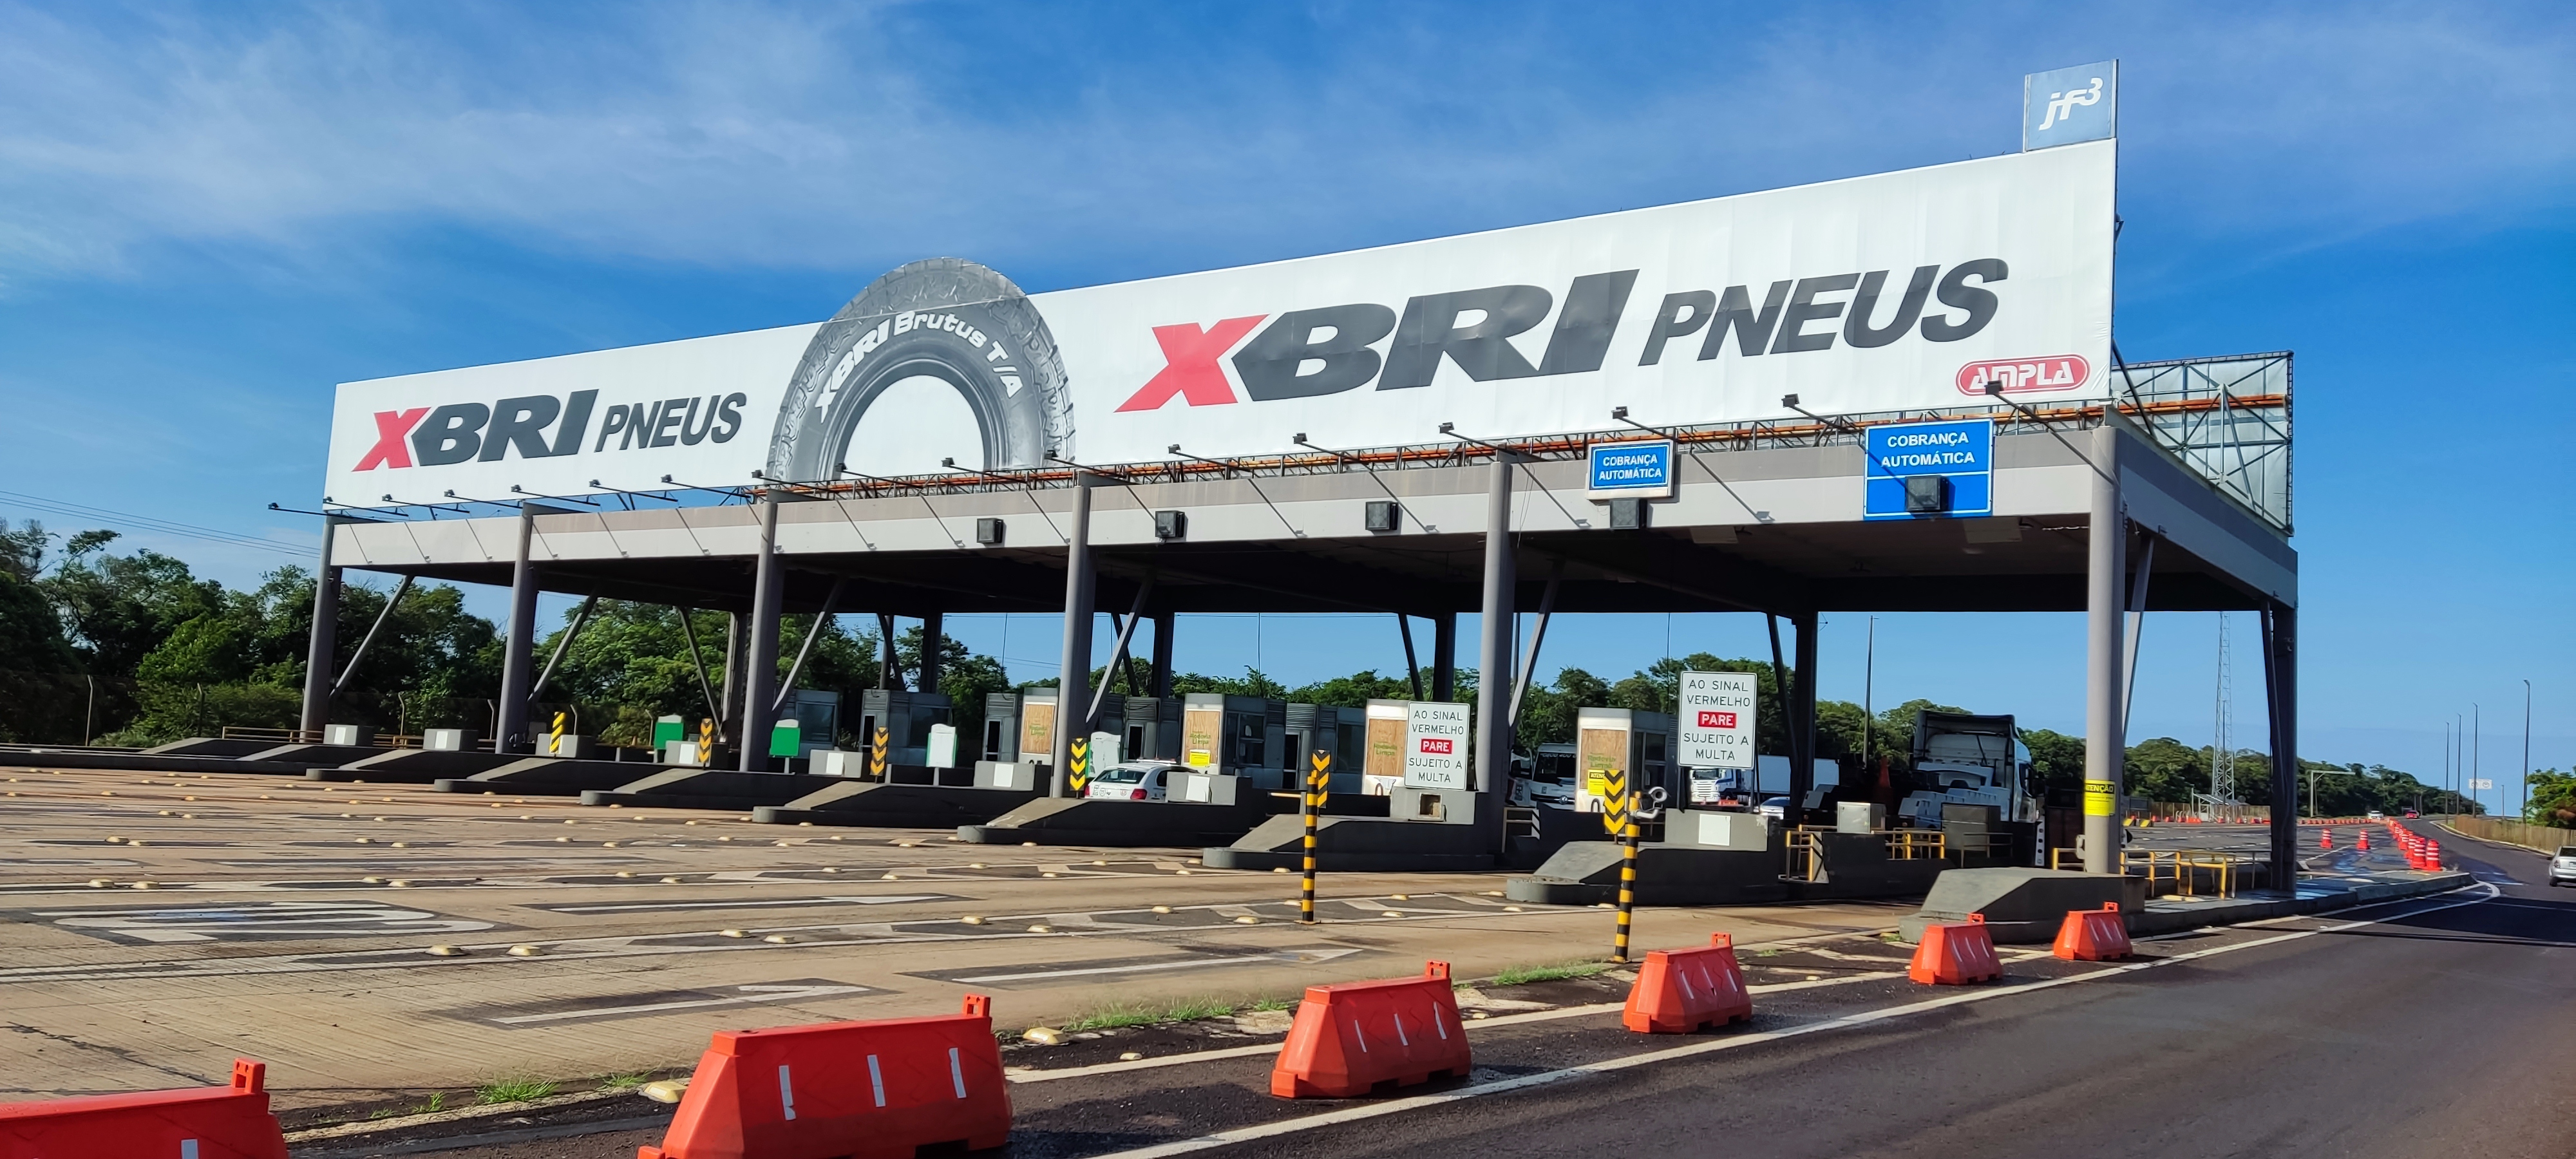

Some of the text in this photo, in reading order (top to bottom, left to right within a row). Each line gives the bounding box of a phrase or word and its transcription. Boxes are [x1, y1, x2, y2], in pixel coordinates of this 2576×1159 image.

[1113, 258, 2009, 413] XBRI PNEUS
[814, 310, 1023, 424] XBRI Brutus T/A
[1969, 361, 2076, 390] AMPLA
[351, 389, 746, 472] XBRI PNEUS
[1888, 432, 1969, 447] COBRANÇA
[1603, 455, 1658, 466] COBRANÇA
[1881, 451, 1975, 467] AUTOMÁTICA
[1598, 467, 1662, 480] AUTOMÁTICA
[1689, 679, 1748, 692] AO SINAL
[1687, 695, 1750, 706] VERMELHO
[1414, 710, 1463, 721] AO SINAL
[1701, 713, 1734, 726] PARE
[1412, 724, 1464, 735] VERMELHO
[1684, 733, 1748, 745] SUJEITO A
[1423, 741, 1450, 752] PARE
[1696, 749, 1735, 760] MULTA
[1409, 758, 1463, 769] SUJEITO A
[1419, 772, 1451, 782] MULTA
[2086, 784, 2114, 793] TENÇÃO
